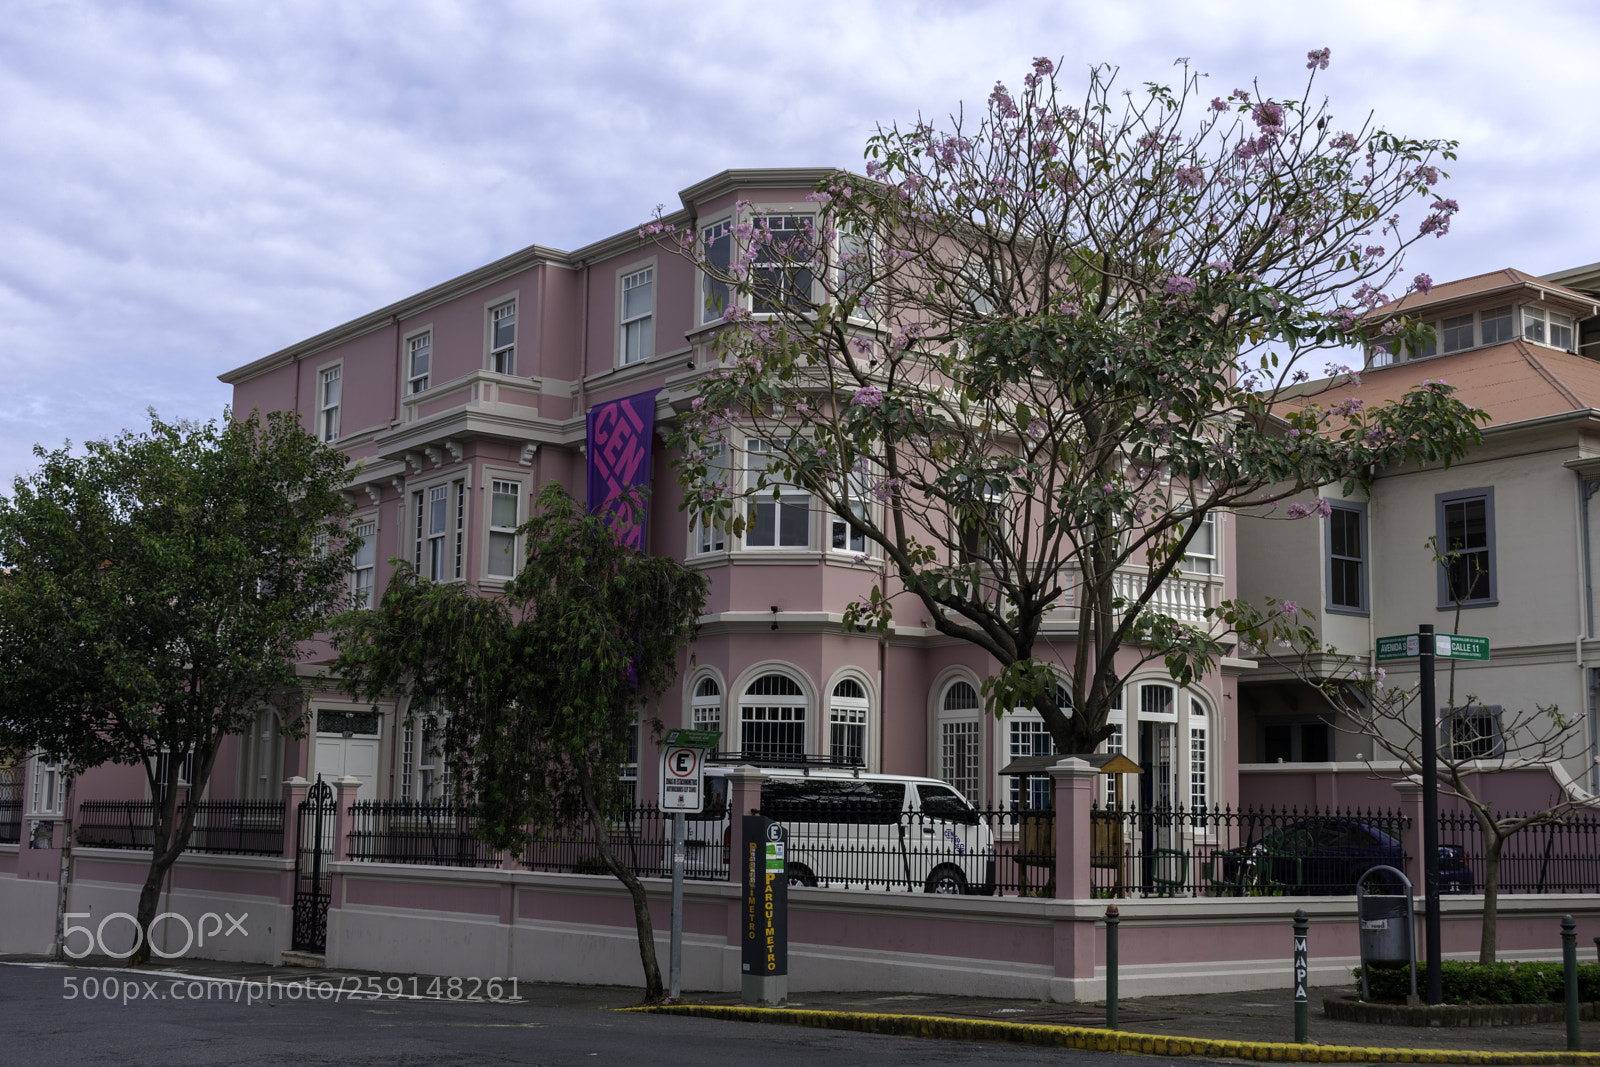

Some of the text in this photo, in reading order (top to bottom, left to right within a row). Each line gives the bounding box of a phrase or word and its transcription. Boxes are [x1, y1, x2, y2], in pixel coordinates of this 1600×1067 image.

[1380, 642, 1402, 653] AVENIDA
[1402, 641, 1407, 651] 9
[1451, 642, 1480, 653] CALLE 11
[676, 753, 690, 771] E
[770, 825, 779, 840] E
[765, 873, 776, 971] PARQUÍMETRO
[1294, 938, 1307, 998] MAPA
